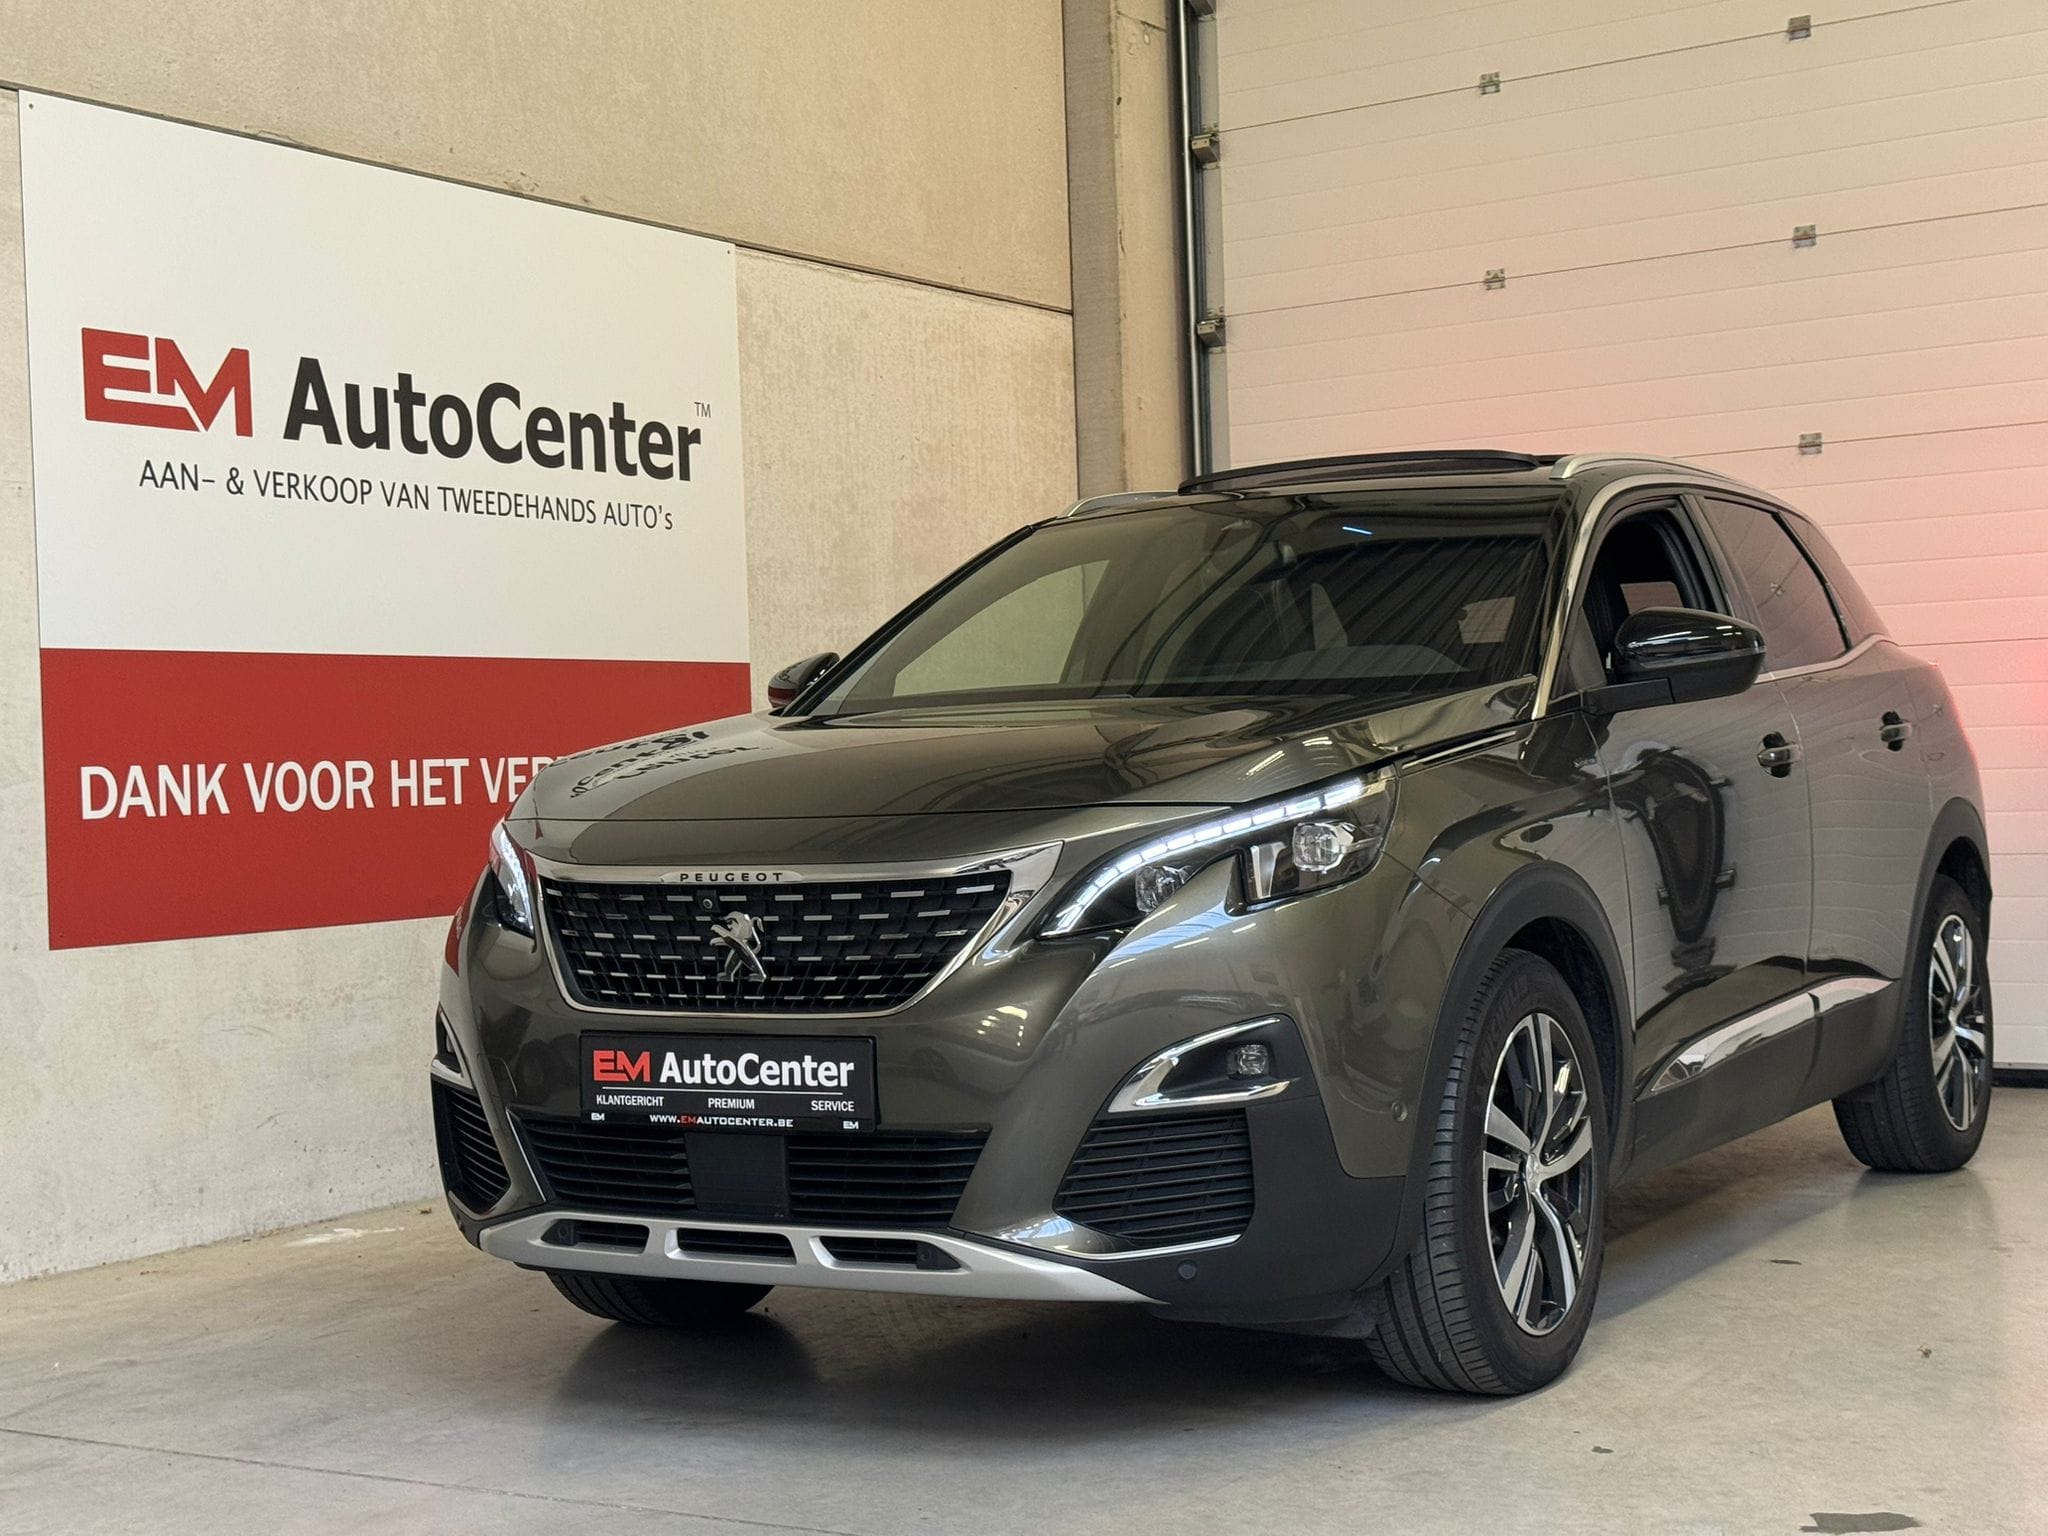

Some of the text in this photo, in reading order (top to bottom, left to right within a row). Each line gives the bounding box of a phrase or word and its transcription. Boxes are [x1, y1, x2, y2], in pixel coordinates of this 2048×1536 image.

[82, 327, 253, 437] EM
[283, 356, 702, 482] AutoCenter
[139, 459, 673, 530] AAN- & VERKOOP VAN TWEEDEHANDS AUTO's
[80, 763, 230, 820] DANK
[243, 760, 375, 813] VOOR
[390, 758, 470, 807] HET
[680, 872, 783, 882] PEUGEOT
[592, 1050, 855, 1088] EM AutoCenter
[596, 1094, 855, 1112] KLANTGERICHT PREMIUM SERVICE
[649, 1113, 794, 1128] WWW.EMAUTOCENTER.BE
